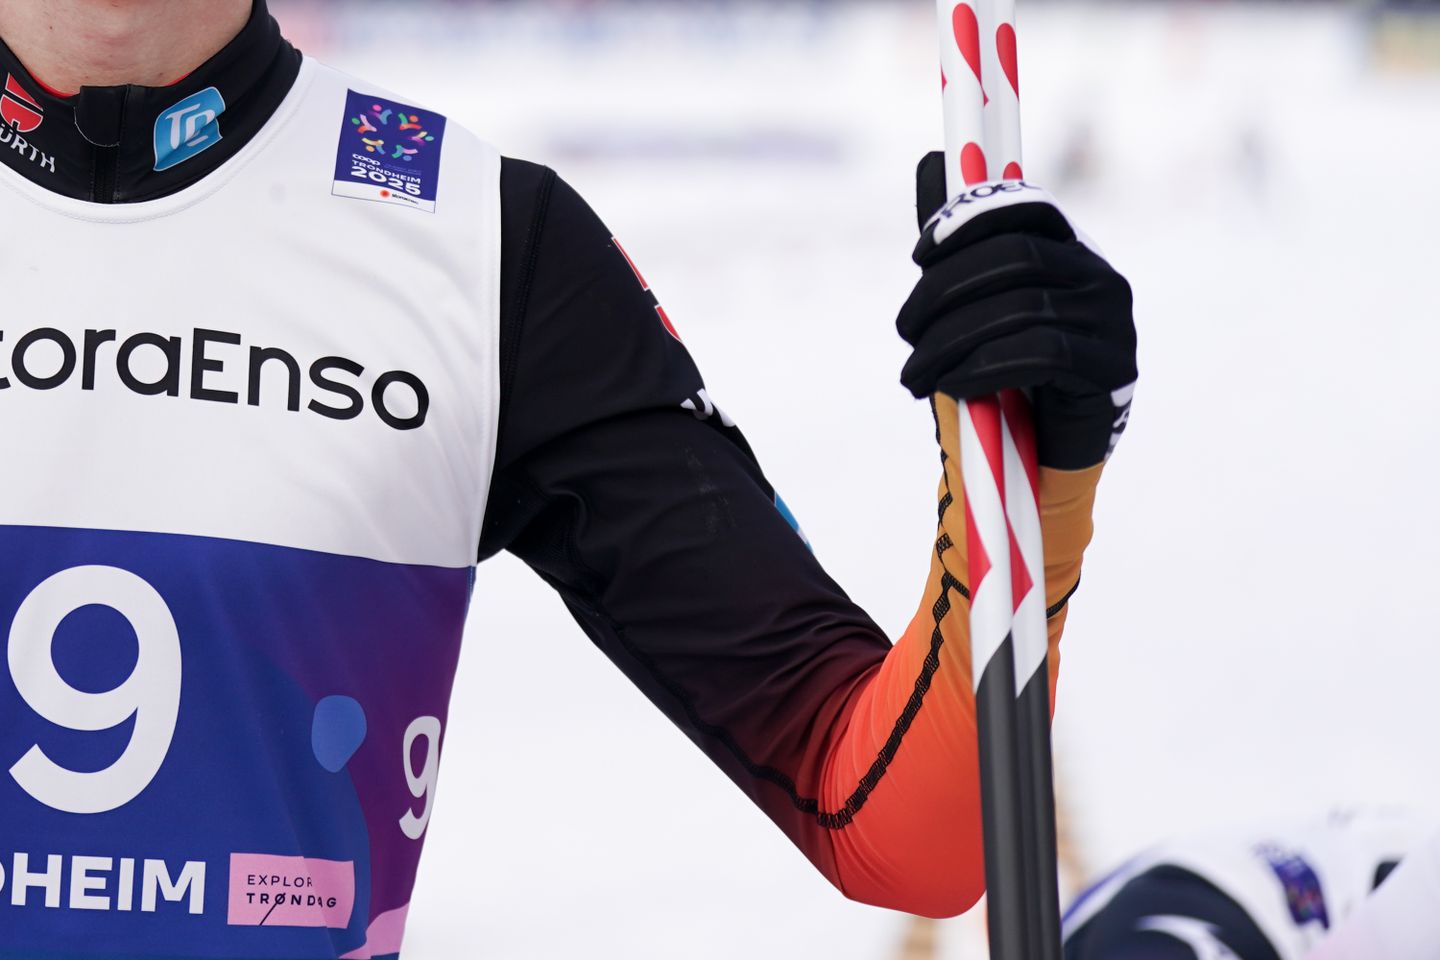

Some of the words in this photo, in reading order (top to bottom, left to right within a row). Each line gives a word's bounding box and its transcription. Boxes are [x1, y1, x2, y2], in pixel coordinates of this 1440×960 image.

[350, 166, 421, 196] 2025
[351, 159, 421, 184] TRONDHEIM
[7, 564, 182, 814] 9
[398, 715, 441, 840] 9
